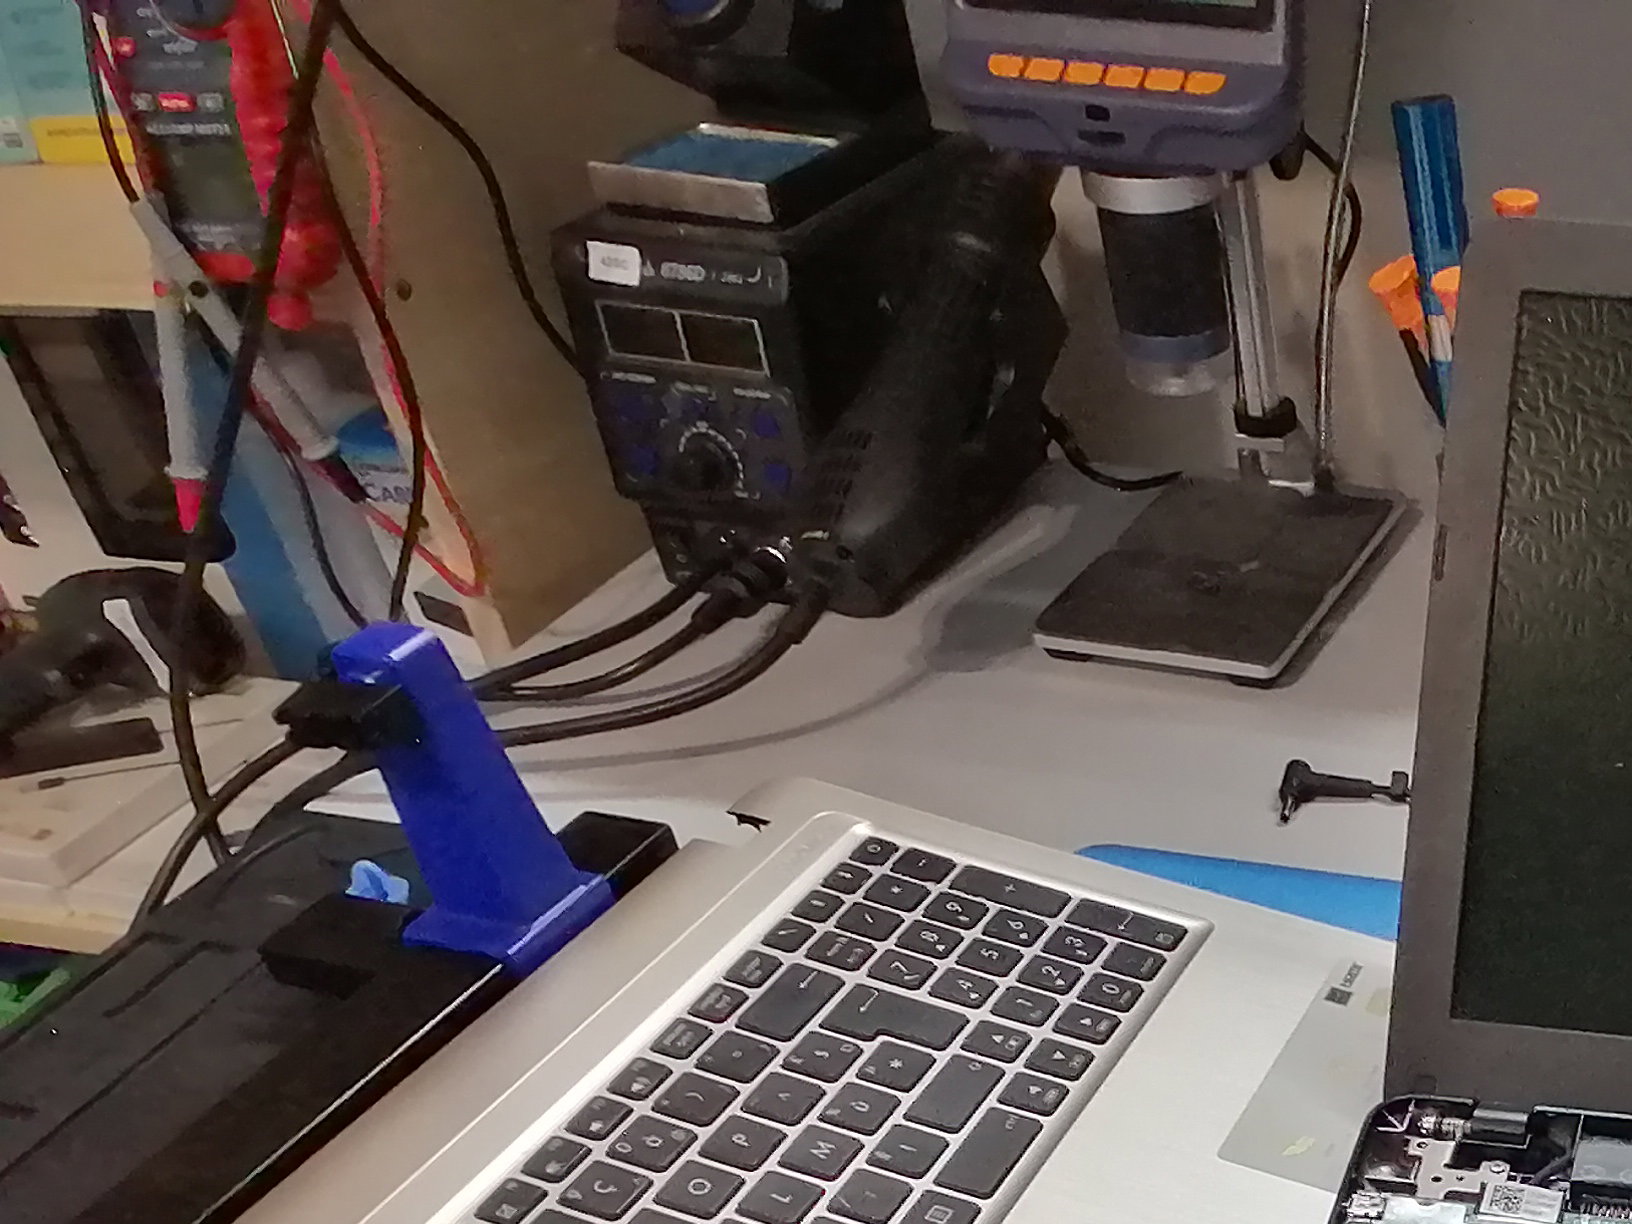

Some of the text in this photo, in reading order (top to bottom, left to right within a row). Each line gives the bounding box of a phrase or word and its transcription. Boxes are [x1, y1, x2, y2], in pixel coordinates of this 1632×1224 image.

[979, 947, 999, 960] 5
[889, 960, 908, 973] 7
[1040, 964, 1060, 977] 2
[809, 1140, 836, 1159] M
[687, 1177, 711, 1195] O
[731, 1132, 749, 1147] P
